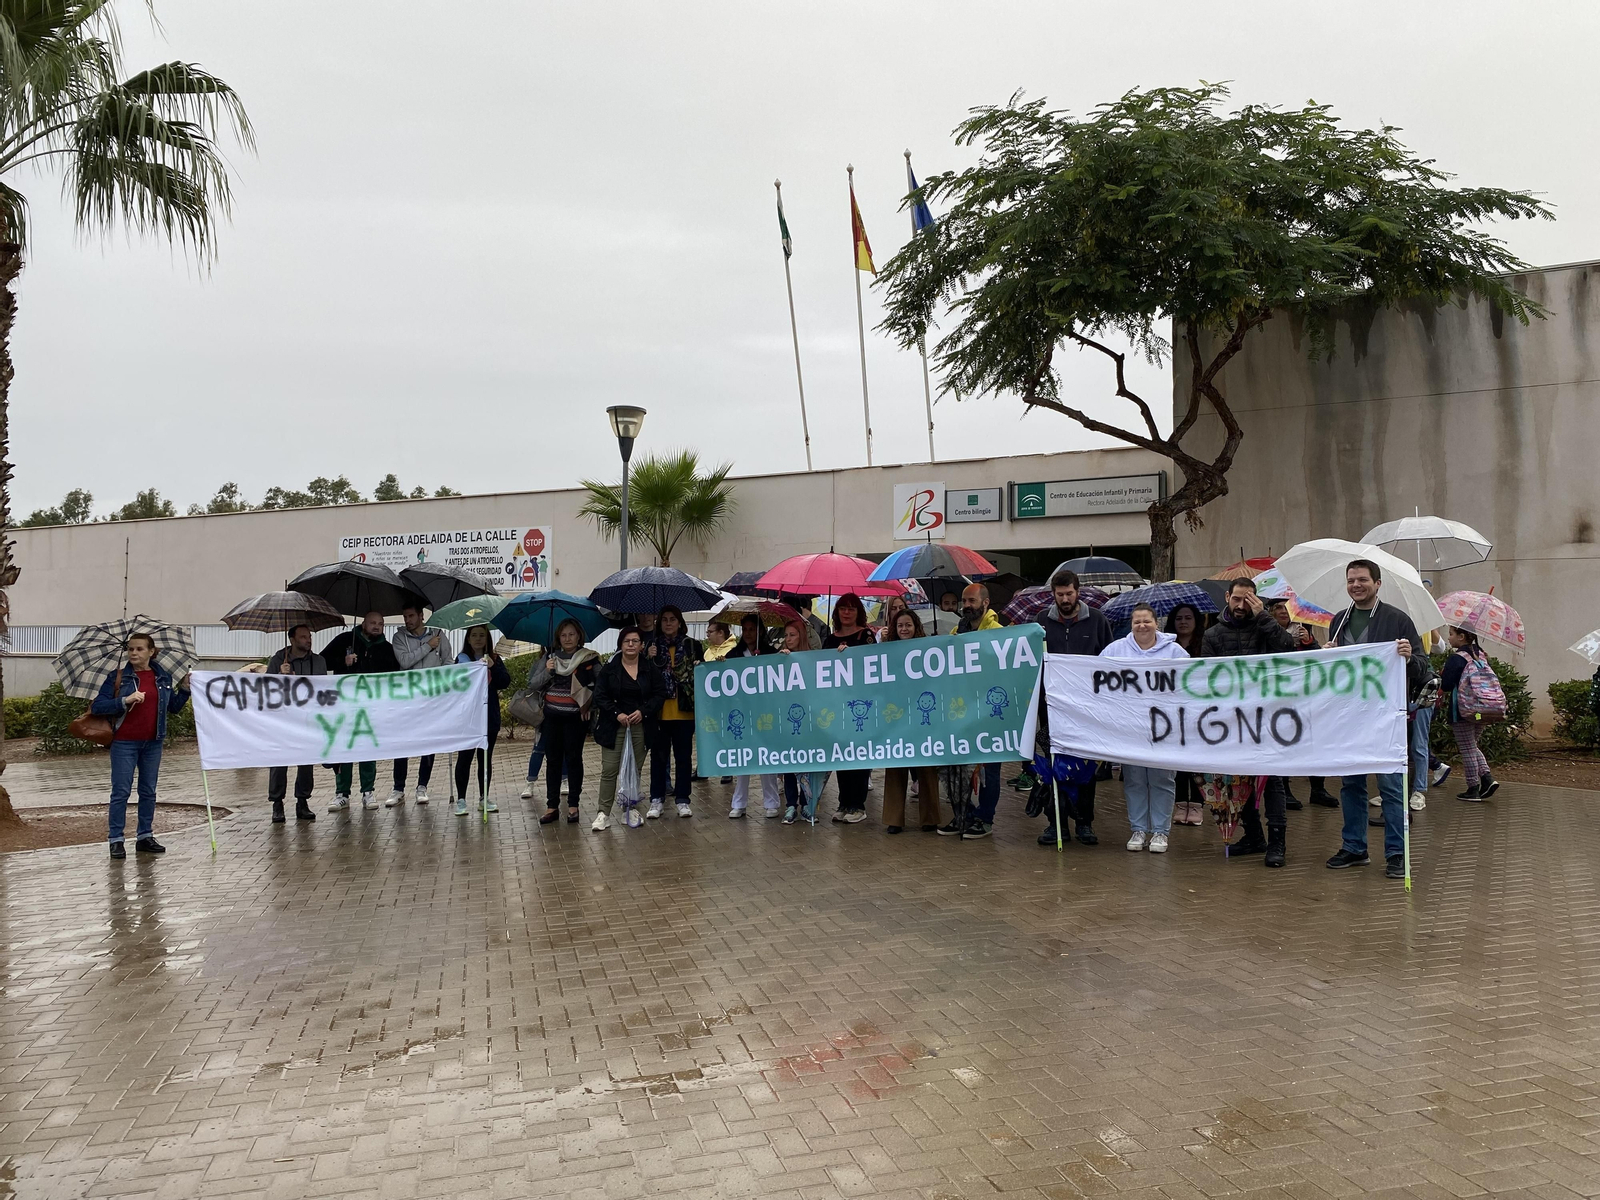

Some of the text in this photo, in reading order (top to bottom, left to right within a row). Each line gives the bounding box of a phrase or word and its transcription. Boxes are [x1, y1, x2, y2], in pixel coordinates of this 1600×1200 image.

[1076, 489, 1103, 498] Educación
[1104, 488, 1123, 496] Infantil
[1129, 487, 1152, 495] Primaria
[972, 507, 991, 516] bilingüe
[342, 529, 517, 549] CEIP RECTORA ADELAIDA DE LA CALLE
[526, 538, 543, 547] STOP
[476, 567, 501, 575] SEGURIDAD
[477, 556, 503, 564] ATROPELLO
[704, 636, 1038, 698] COCINA EN EL COLE YA
[1093, 656, 1387, 700] POR UN COMEDOR
[206, 674, 315, 711] CAMBIO
[337, 667, 472, 703] CATERING
[314, 708, 379, 758] YA
[1149, 706, 1303, 747] DIGNO
[715, 730, 1020, 768] CEIP Rectora Adelaida de la Call
